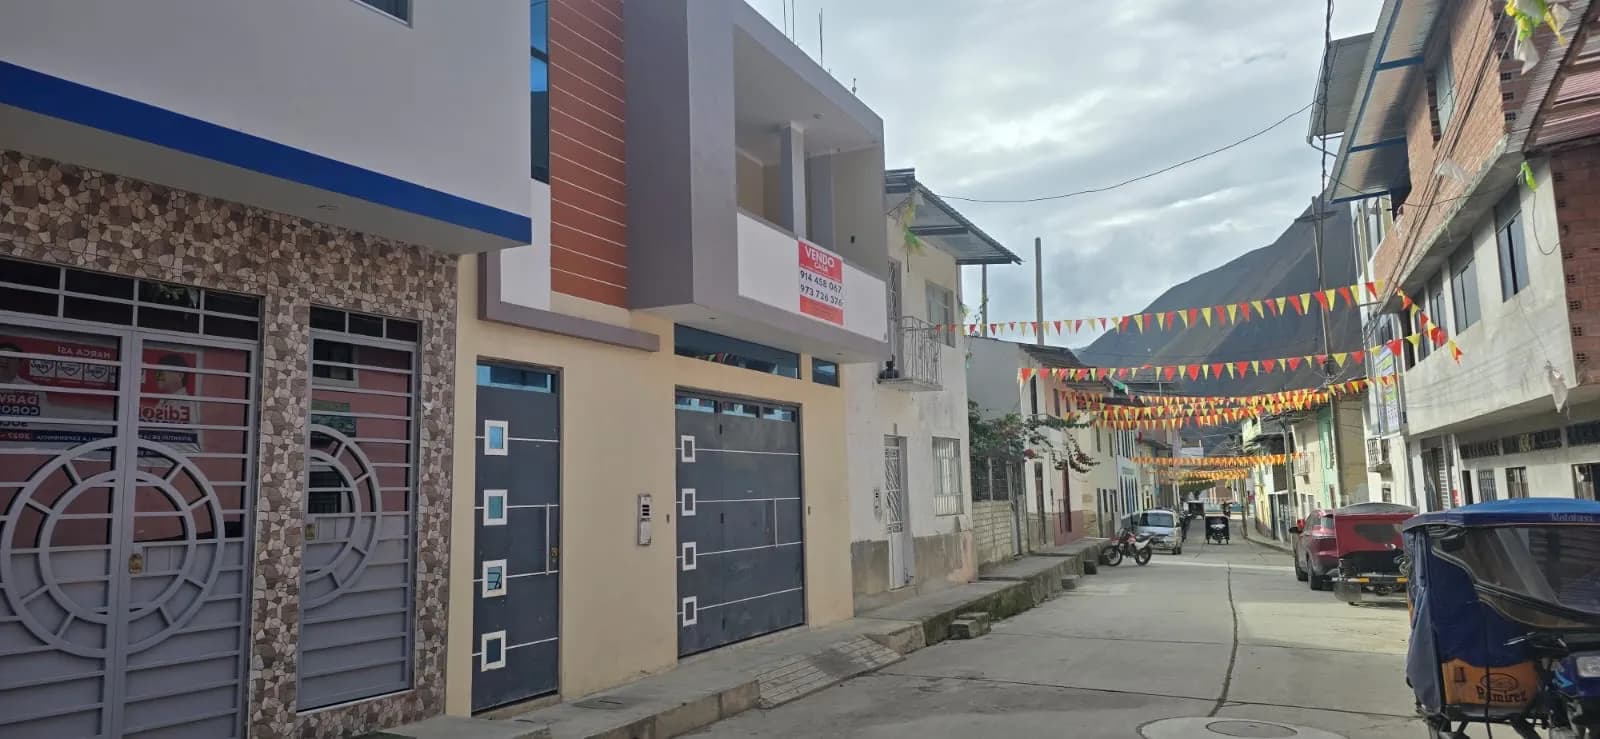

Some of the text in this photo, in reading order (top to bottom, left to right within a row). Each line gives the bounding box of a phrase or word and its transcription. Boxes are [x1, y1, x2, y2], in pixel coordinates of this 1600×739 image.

[805, 246, 834, 267] VENDO
[800, 270, 812, 281] 914
[800, 283, 814, 296] 973
[1475, 685, 1528, 704] Rmirez
